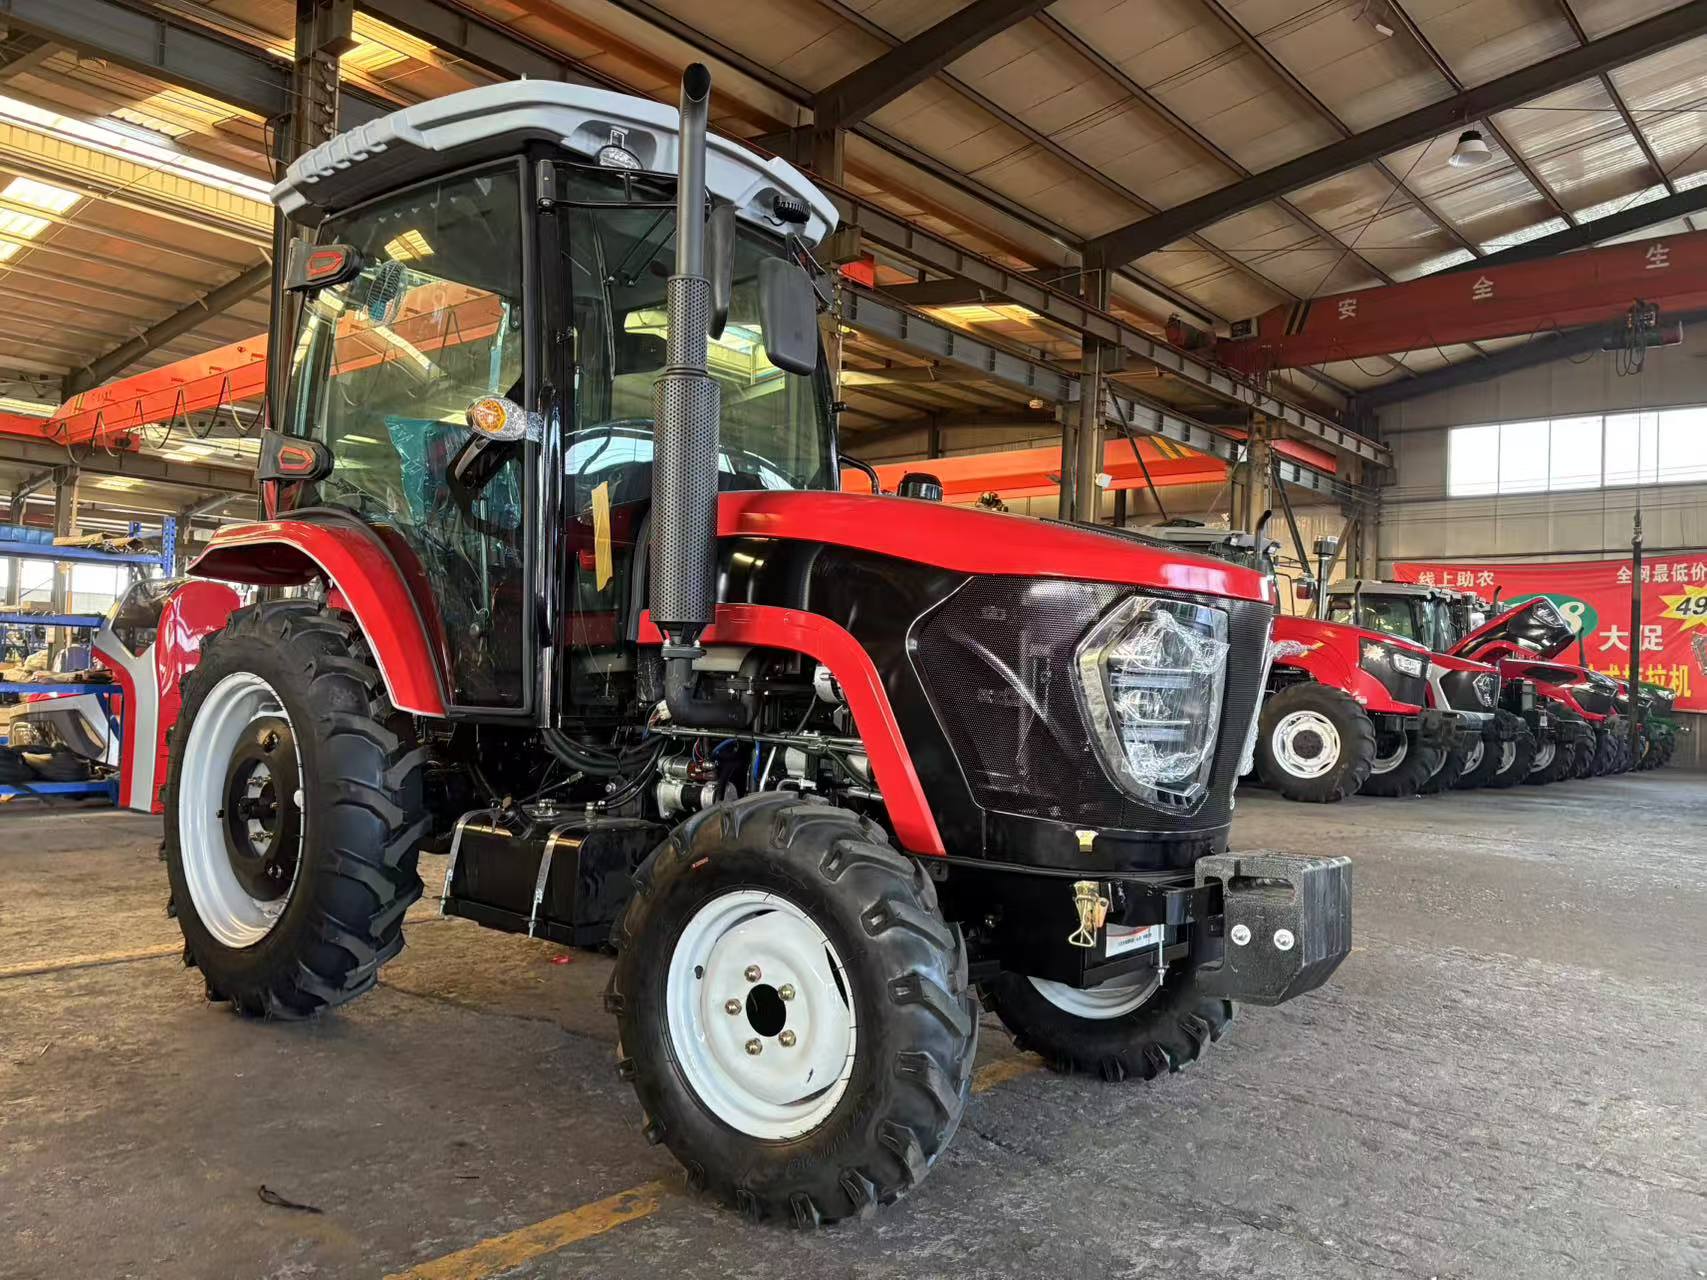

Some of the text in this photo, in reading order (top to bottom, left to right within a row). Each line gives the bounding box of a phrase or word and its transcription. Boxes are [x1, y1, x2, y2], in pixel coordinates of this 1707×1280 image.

[1418, 571, 1495, 588] 线上助农
[1598, 624, 1664, 651] 大促
